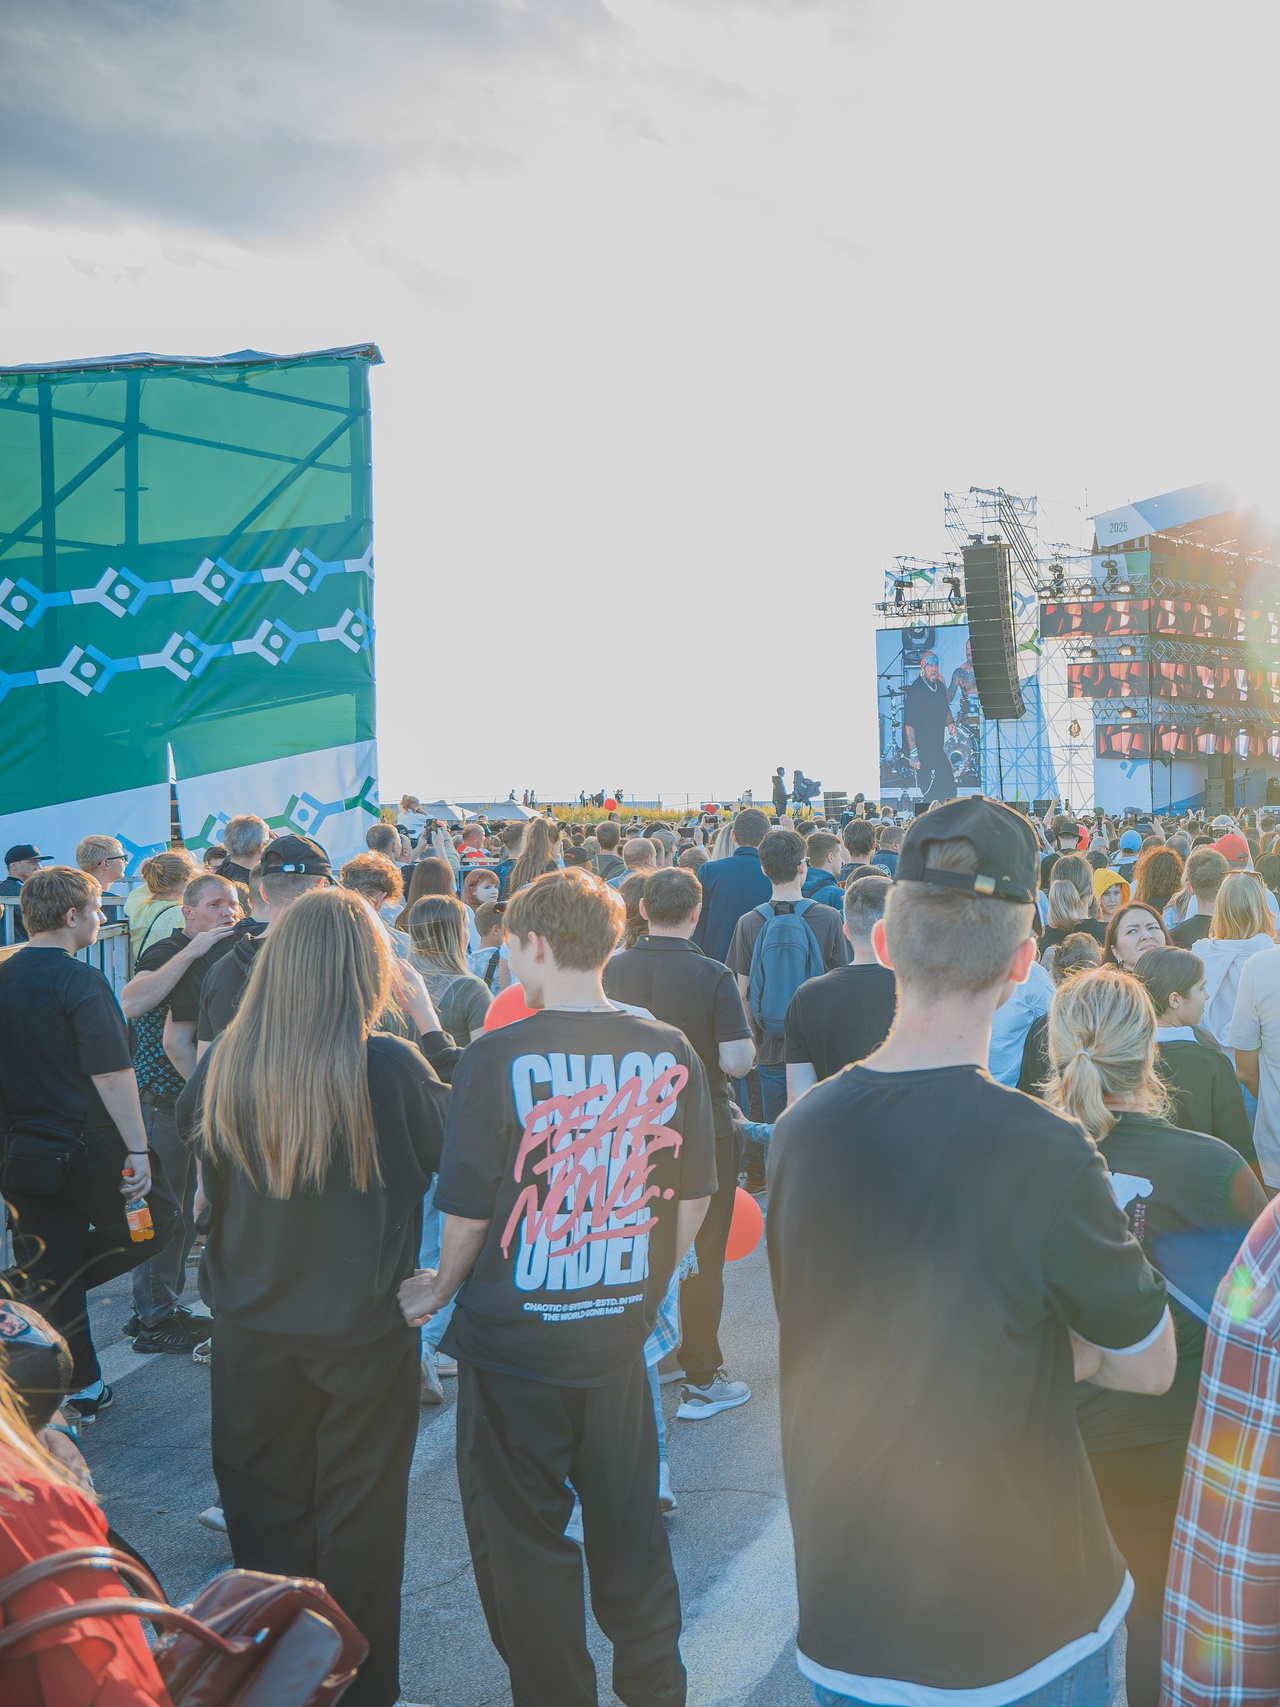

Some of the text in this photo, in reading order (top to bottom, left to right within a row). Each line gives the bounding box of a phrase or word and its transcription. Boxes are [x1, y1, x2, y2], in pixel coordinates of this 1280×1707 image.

[1109, 521, 1129, 534] 2025
[512, 1052, 679, 1133] CHAOS
[523, 1302, 561, 1313] CHAOTIC
[543, 1313, 560, 1322] THE
[605, 1306, 625, 1315] MAD
